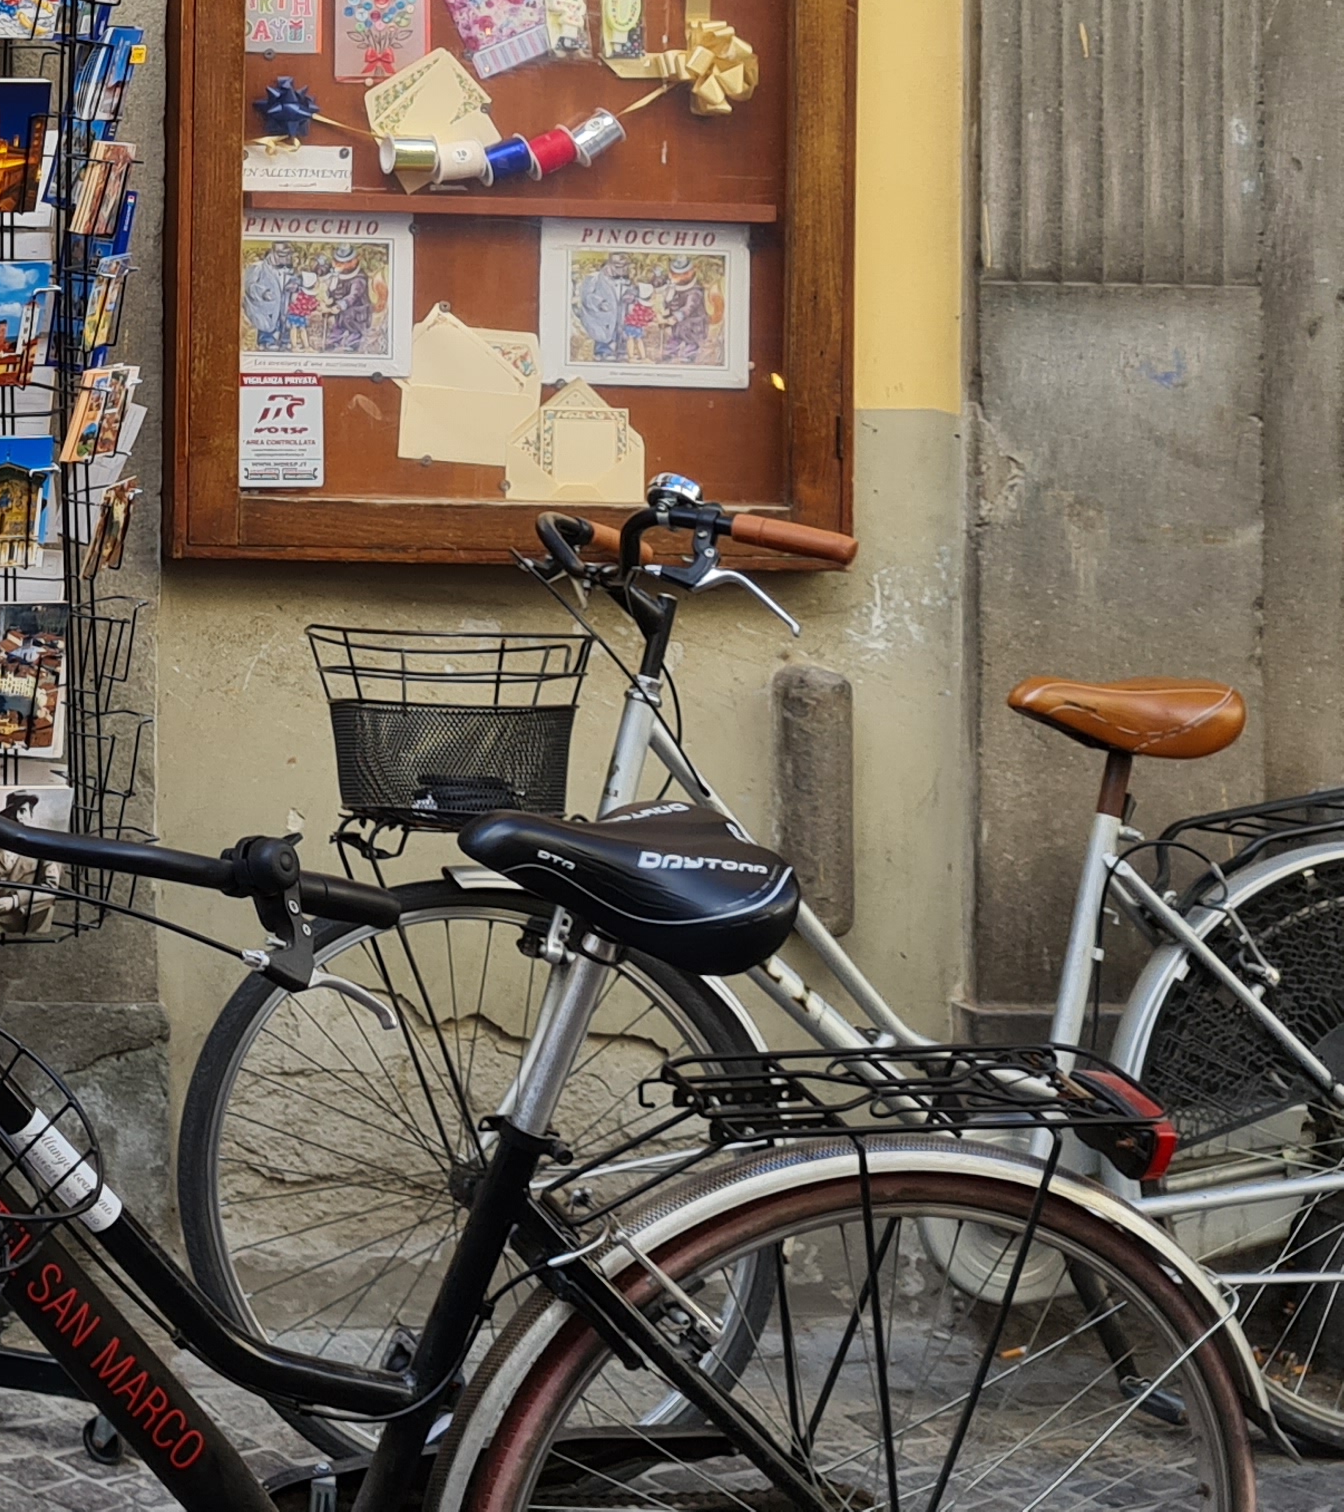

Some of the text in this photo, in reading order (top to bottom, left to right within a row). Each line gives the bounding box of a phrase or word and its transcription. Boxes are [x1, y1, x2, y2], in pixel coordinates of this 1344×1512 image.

[244, 217, 380, 236] PINOCCHIO
[580, 227, 718, 248] PINOCCHIO
[27, 1264, 205, 1469] SAN MARCO
